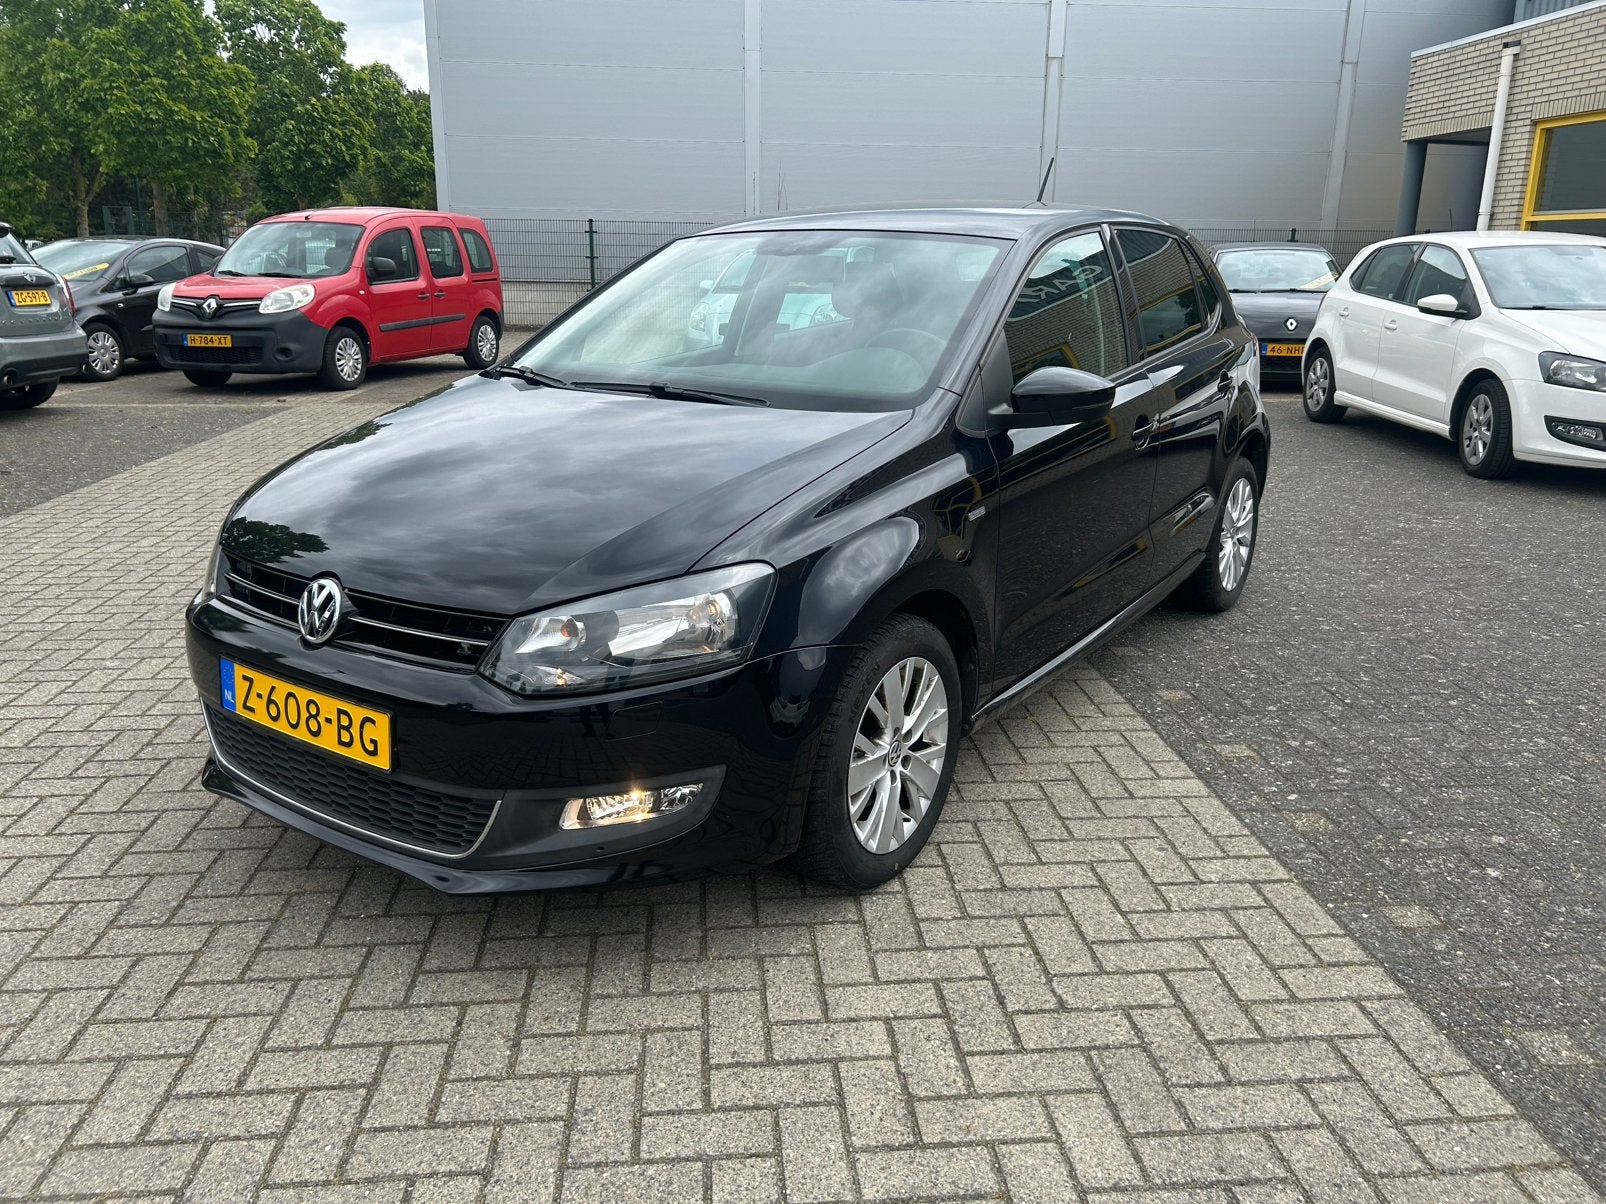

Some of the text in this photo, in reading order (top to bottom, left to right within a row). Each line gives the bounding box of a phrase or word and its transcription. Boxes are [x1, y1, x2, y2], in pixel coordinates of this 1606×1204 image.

[15, 291, 48, 304] ZG-597-B
[189, 335, 229, 346] H-784-XT
[224, 688, 235, 703] NL
[241, 673, 379, 757] Z-608-BG
